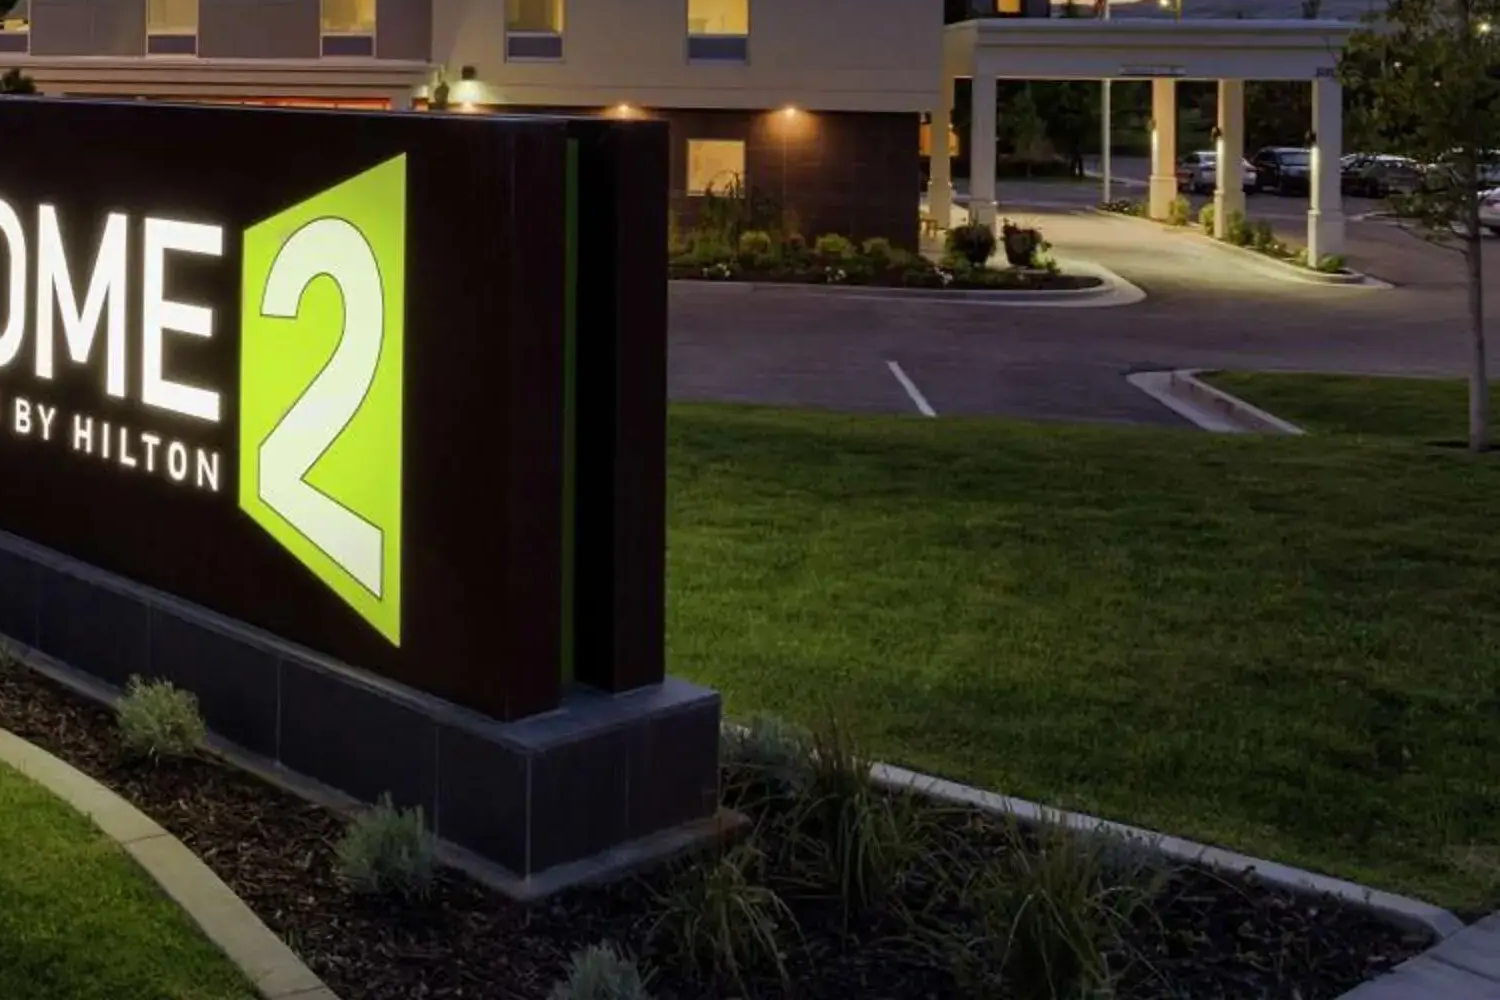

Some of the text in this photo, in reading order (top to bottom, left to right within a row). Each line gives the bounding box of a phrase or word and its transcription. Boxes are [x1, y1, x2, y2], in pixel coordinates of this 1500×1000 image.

[15, 397, 56, 440] BY
[73, 413, 220, 491] HILTON
[257, 216, 385, 602] 2
